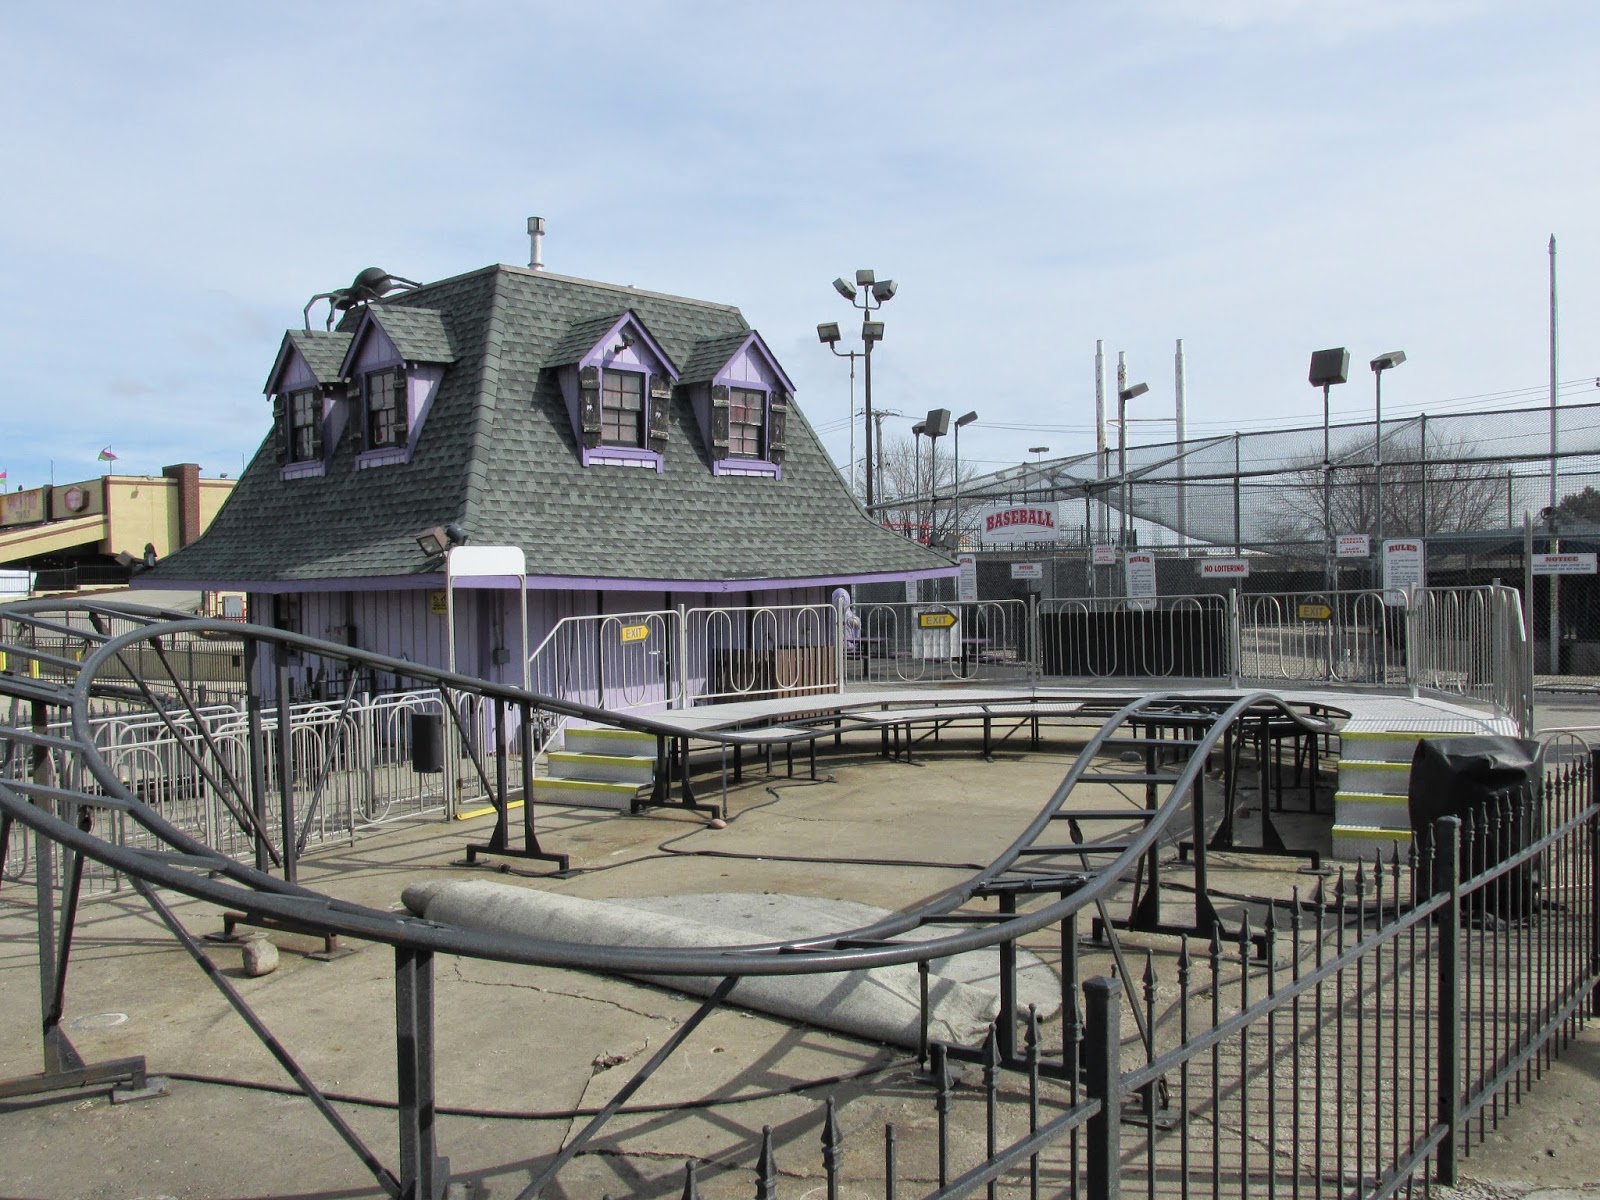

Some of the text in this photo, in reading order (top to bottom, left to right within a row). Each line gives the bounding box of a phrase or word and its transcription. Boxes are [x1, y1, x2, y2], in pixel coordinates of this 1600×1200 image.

[986, 509, 1054, 532] BASEBALL
[1388, 543, 1418, 553] RULES
[1129, 555, 1151, 564] RULES
[1204, 563, 1245, 573] NO LOITERING
[1303, 606, 1324, 616] EXIT
[925, 615, 948, 625] EXIT
[626, 628, 642, 638] EXIT
